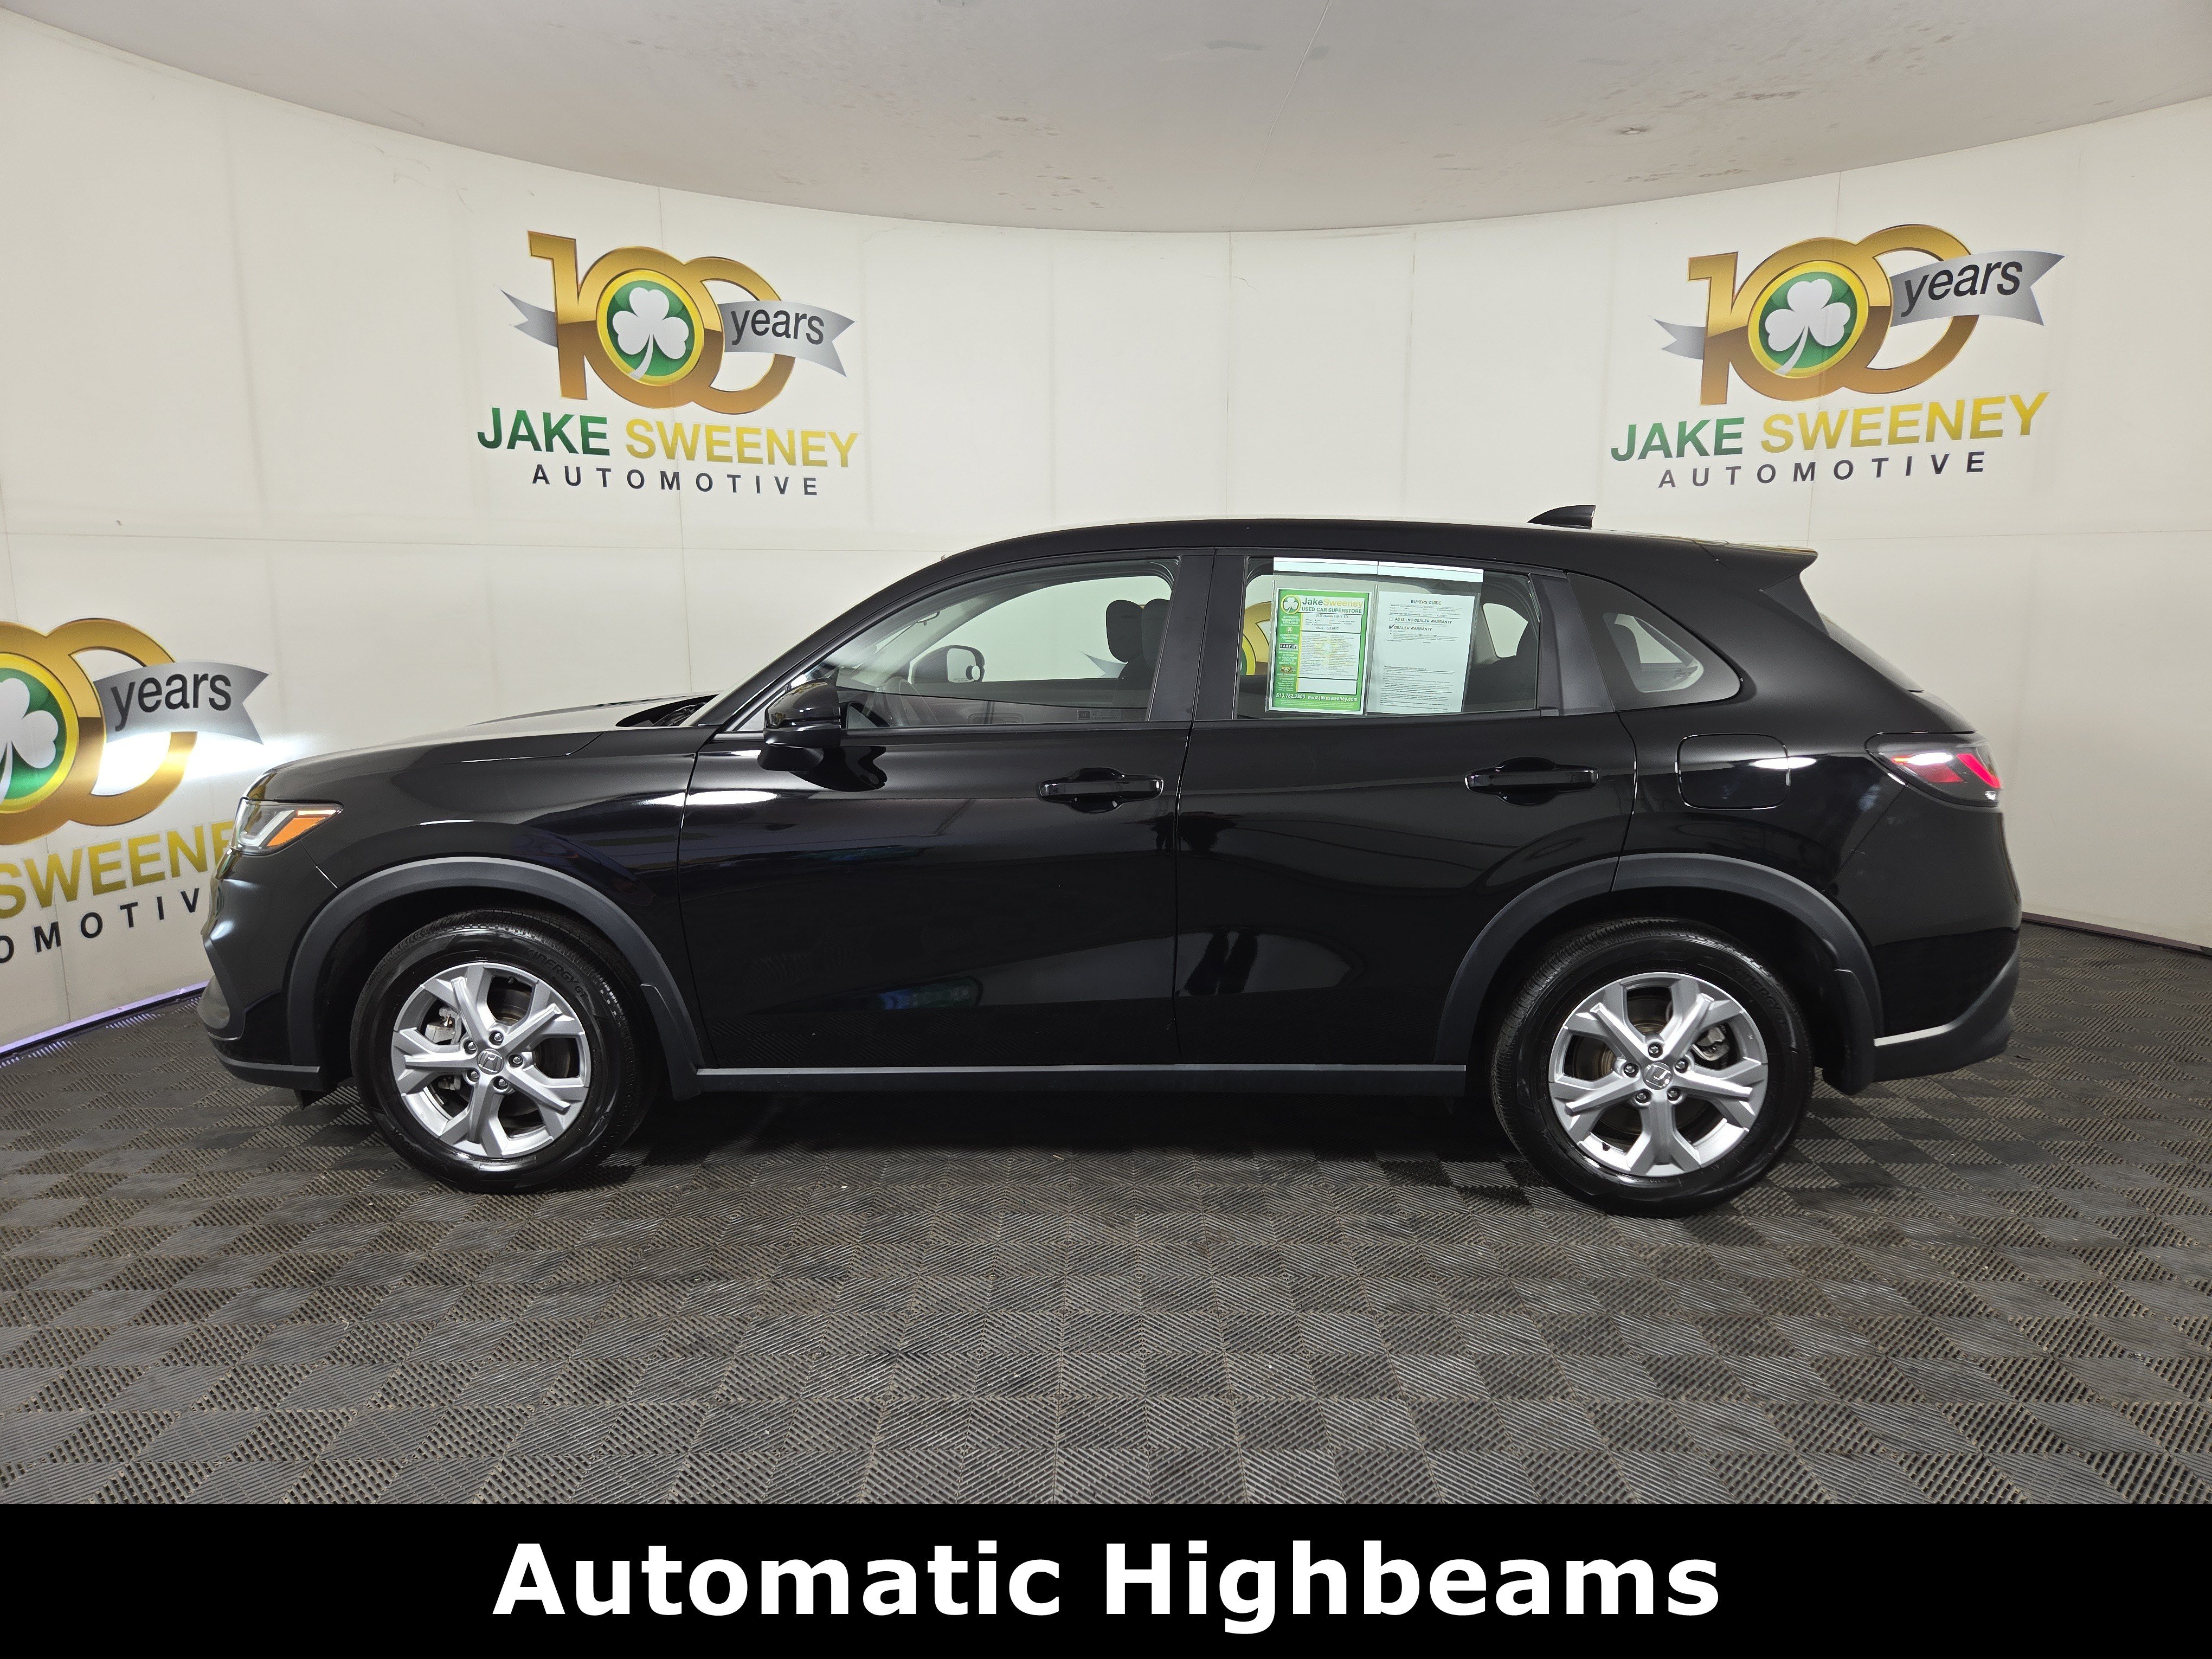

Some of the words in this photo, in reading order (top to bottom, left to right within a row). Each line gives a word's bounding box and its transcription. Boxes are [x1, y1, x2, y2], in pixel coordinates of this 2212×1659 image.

[1688, 224, 1980, 405] 100
[1901, 260, 2022, 318] years
[528, 230, 796, 415] 100
[730, 307, 825, 345] years
[477, 407, 610, 456] JAKE
[625, 418, 859, 468] SWEENEY
[1611, 417, 1745, 461] JAKE
[1761, 391, 2050, 454] SWEENEY
[531, 464, 818, 496] AUTOMOTIVE
[1658, 451, 1985, 488] AUTOMOTIVE
[0, 618, 197, 845] 00
[111, 672, 232, 731] years
[0, 820, 234, 918] SWEEN
[0, 888, 200, 963] OMOTIV
